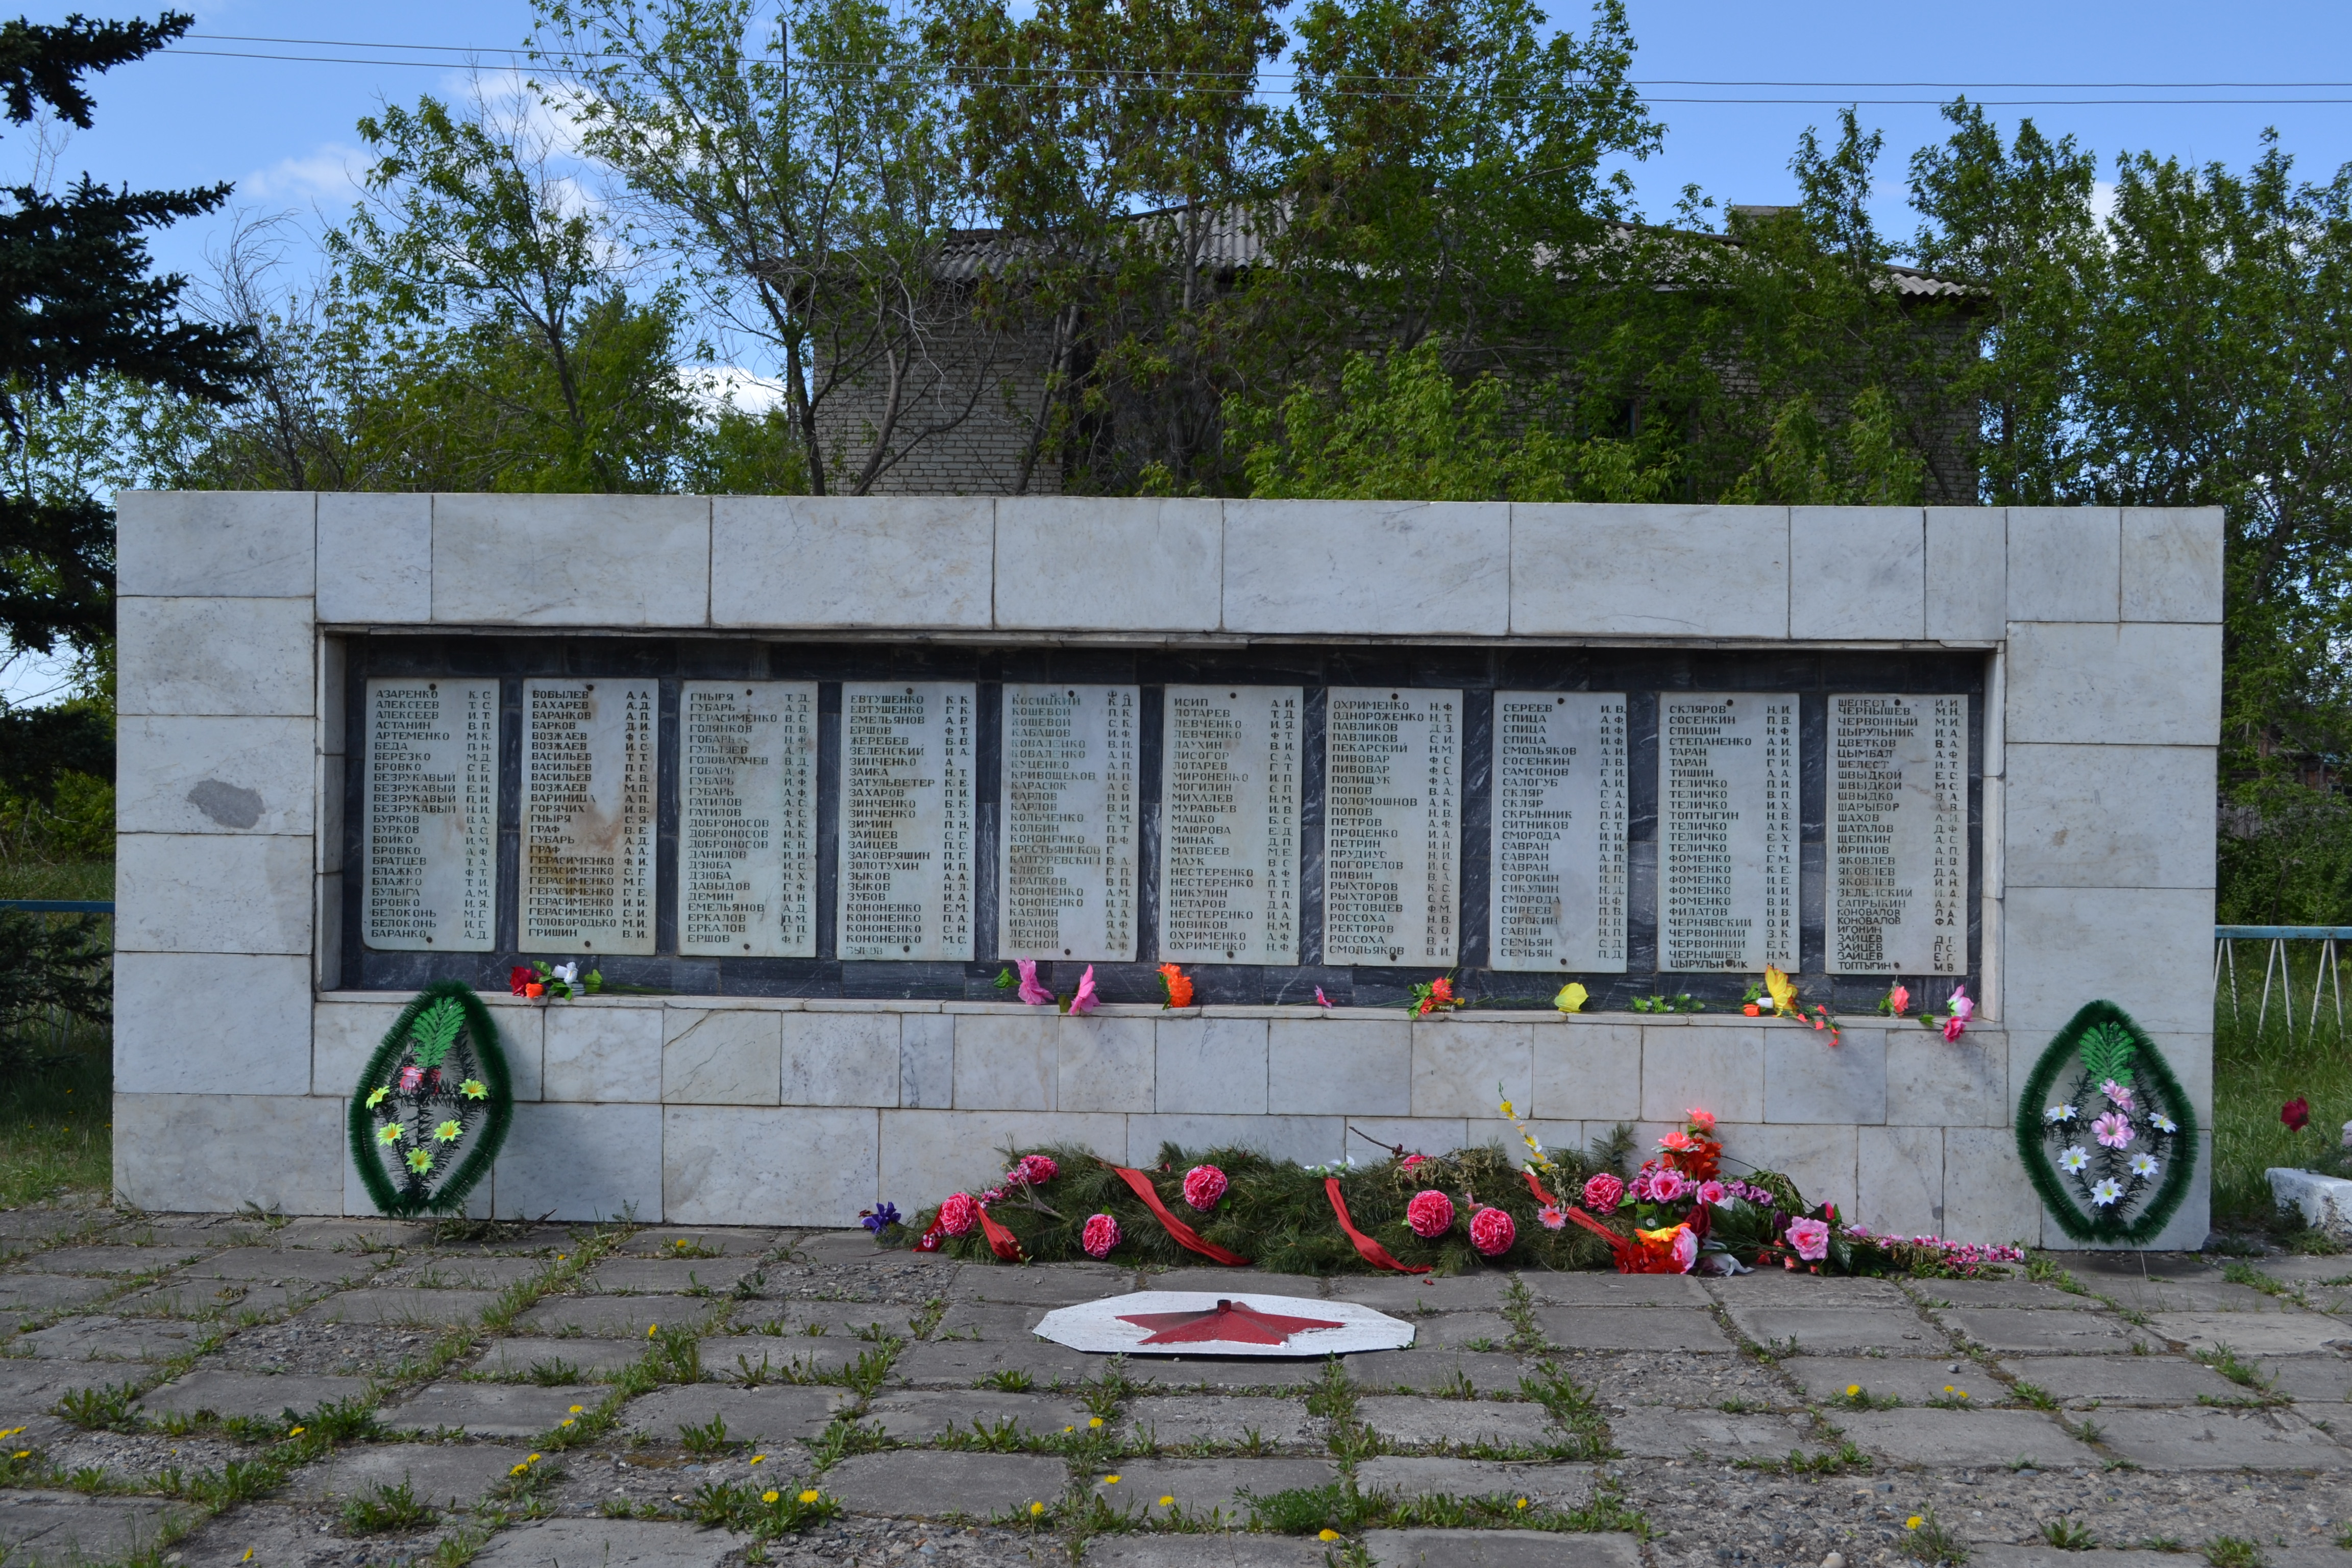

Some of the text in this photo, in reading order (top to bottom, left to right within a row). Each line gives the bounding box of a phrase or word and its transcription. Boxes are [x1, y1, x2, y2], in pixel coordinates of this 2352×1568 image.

[690, 693, 733, 702] ГНЫРЯ
[1174, 698, 1208, 707] ИСИП
[375, 700, 439, 709] АЛЕКСЕЕВ
[532, 700, 589, 709] БАХАРЕВ
[690, 703, 736, 713] ГУБАРЬ
[1503, 703, 1552, 713] СЕРЕЕВ
[850, 705, 923, 715] ЕВТУШЕНКО
[1012, 707, 1070, 717] КОШЕВОЙ
[1174, 708, 1230, 719] ЛОТАРЕВ
[532, 710, 592, 721] БАРАНКОВ
[1333, 711, 1424, 722] ОДНОРОЖЕНКО
[1669, 716, 1735, 724] СОСЕНКИН
[375, 721, 431, 730] АСТАНИН
[532, 720, 577, 730] БАРКОВ
[1333, 722, 1398, 732] ПАВЛИКОВ
[1503, 725, 1547, 735] СПИЦА
[375, 731, 450, 741] АРТЕМЕНКО
[1012, 728, 1070, 738] КАБАШОВ
[1669, 726, 1721, 736] СПИЦИН
[1837, 727, 1915, 738] ЦЫРУЛЬНИК
[374, 742, 408, 751] БЕДА
[531, 742, 587, 752] ВОЗЖАЕВ
[1669, 737, 1752, 747] СТЕПАНЕНКО
[1837, 739, 1896, 749] ЦВЕТКОВ
[1332, 742, 1407, 753] ПЕКАРСКИЙ
[1503, 746, 1577, 755] СМОЛЬЯКОВ
[374, 752, 431, 762] БЕРЕЗКО
[1173, 751, 1229, 761] ЛИСОГОР
[1837, 748, 1893, 759] ЦЫМБАЛ
[1332, 754, 1390, 764] ПИВОВАР
[1669, 758, 1707, 767] ТАРАН
[374, 771, 456, 782] БЕЗРУКАВЫЙ
[1503, 767, 1569, 776] САМСОНОВ
[1669, 769, 1713, 777] ТИШИН
[531, 773, 592, 782] ВАСИЛЬЕВ
[1503, 778, 1558, 787] САЛОГУБ
[849, 778, 935, 788] ЗАТУЛЬВЕТЕР
[1172, 781, 1232, 793] МОГИЛИН
[849, 788, 905, 799] ЗАХАРОВ
[1332, 786, 1372, 795] ПОПОВ
[1503, 789, 1544, 797] СКЛЯР
[1669, 790, 1727, 799] ТЕЛИЧКО
[689, 798, 742, 807] ГАТИЛОВ
[1331, 796, 1417, 807] ПОЛОМОШНОВ
[530, 804, 585, 813] ГОРЯЧИХ
[848, 808, 916, 818] ЗИНЧЕНКО
[1171, 803, 1237, 813] МУРАВЬЕВ
[530, 814, 573, 824] ГНЫРЯ
[1011, 813, 1084, 822] КОЛЬЧЕНКО
[1171, 814, 1214, 824] МАЦКО
[1502, 810, 1573, 819] СКРЫННИК
[1669, 811, 1739, 820] ТОПТЫГИН
[1837, 813, 1879, 822] ШАХОВ
[373, 815, 420, 825] БУРКОВ
[689, 818, 769, 828] ДОБРОНОСОВ
[848, 819, 893, 829] ЗИМИН
[1331, 818, 1382, 827] ПЕТРОВ
[1502, 820, 1569, 830] СИТНИКОВ
[1011, 823, 1059, 834] КОЛБИН
[1331, 828, 1398, 839] ПРОЦЕНКО
[1837, 824, 1894, 834] ШАТАЛОВ
[529, 834, 575, 845] ГУБАРЬ
[1171, 836, 1215, 846] МИНАК
[1502, 831, 1561, 841] СМОРОДА
[1837, 834, 1891, 845] ЩЕПКИН
[372, 846, 421, 855] БРОВКО
[688, 849, 747, 860] ДАНИЛОВ
[1837, 845, 1889, 854] ЮРИНОВ
[848, 851, 930, 861] ЗАКОВРЯШИН
[1837, 856, 1895, 866] ЯКОВЛЕВ
[372, 856, 427, 867] БРАТЦЕВ
[688, 861, 732, 871] ДЗЮБА
[848, 861, 919, 871] ЗОЛОТУХИН
[1331, 860, 1404, 871] ПОГОРЕЛОВ
[1010, 865, 1054, 876] КЛЮЕВ
[1669, 864, 1731, 875] ФОМЕНКО
[688, 880, 750, 892] ДАВЫДОВ
[1170, 878, 1254, 888] НЕСТЕРЕНКО
[372, 887, 420, 897] БУЛЫГА
[688, 892, 733, 902] ДЕМИН
[847, 892, 886, 901] ЗУБОВ
[1170, 889, 1228, 898] НИКУЛИН
[1170, 899, 1226, 909] НЕТАРОВ
[1330, 902, 1403, 913] РОСТОВЦЕВ
[372, 909, 436, 918] БЕЛОКОНЬ
[529, 906, 613, 917] ГЕРАСИМЕНКО
[1009, 907, 1059, 918] КАБЛИН
[1669, 907, 1728, 916] ФИЛАТОВ
[528, 917, 617, 928] ГОЛОБОРОДЬКО
[846, 913, 921, 924] КОНОНЕНКО
[1009, 918, 1058, 929] ИВАНОВ
[1837, 915, 1901, 925] КОНОВАЛОВ
[688, 924, 746, 933] ЕРКАЛОВ
[1170, 920, 1228, 930] НОВИКОВ
[1330, 923, 1394, 935] РЕКТОРОВ
[528, 928, 577, 937] ГРИШИН
[688, 934, 730, 943] ЕРШОВ
[1501, 937, 1553, 948] СЕМЬЯН
[1009, 939, 1059, 949] ЛЕСНОЙ
[1669, 950, 1741, 961] ЧЕРНЫШЕВ
[1837, 961, 1891, 971] ТОПТЫГИН
